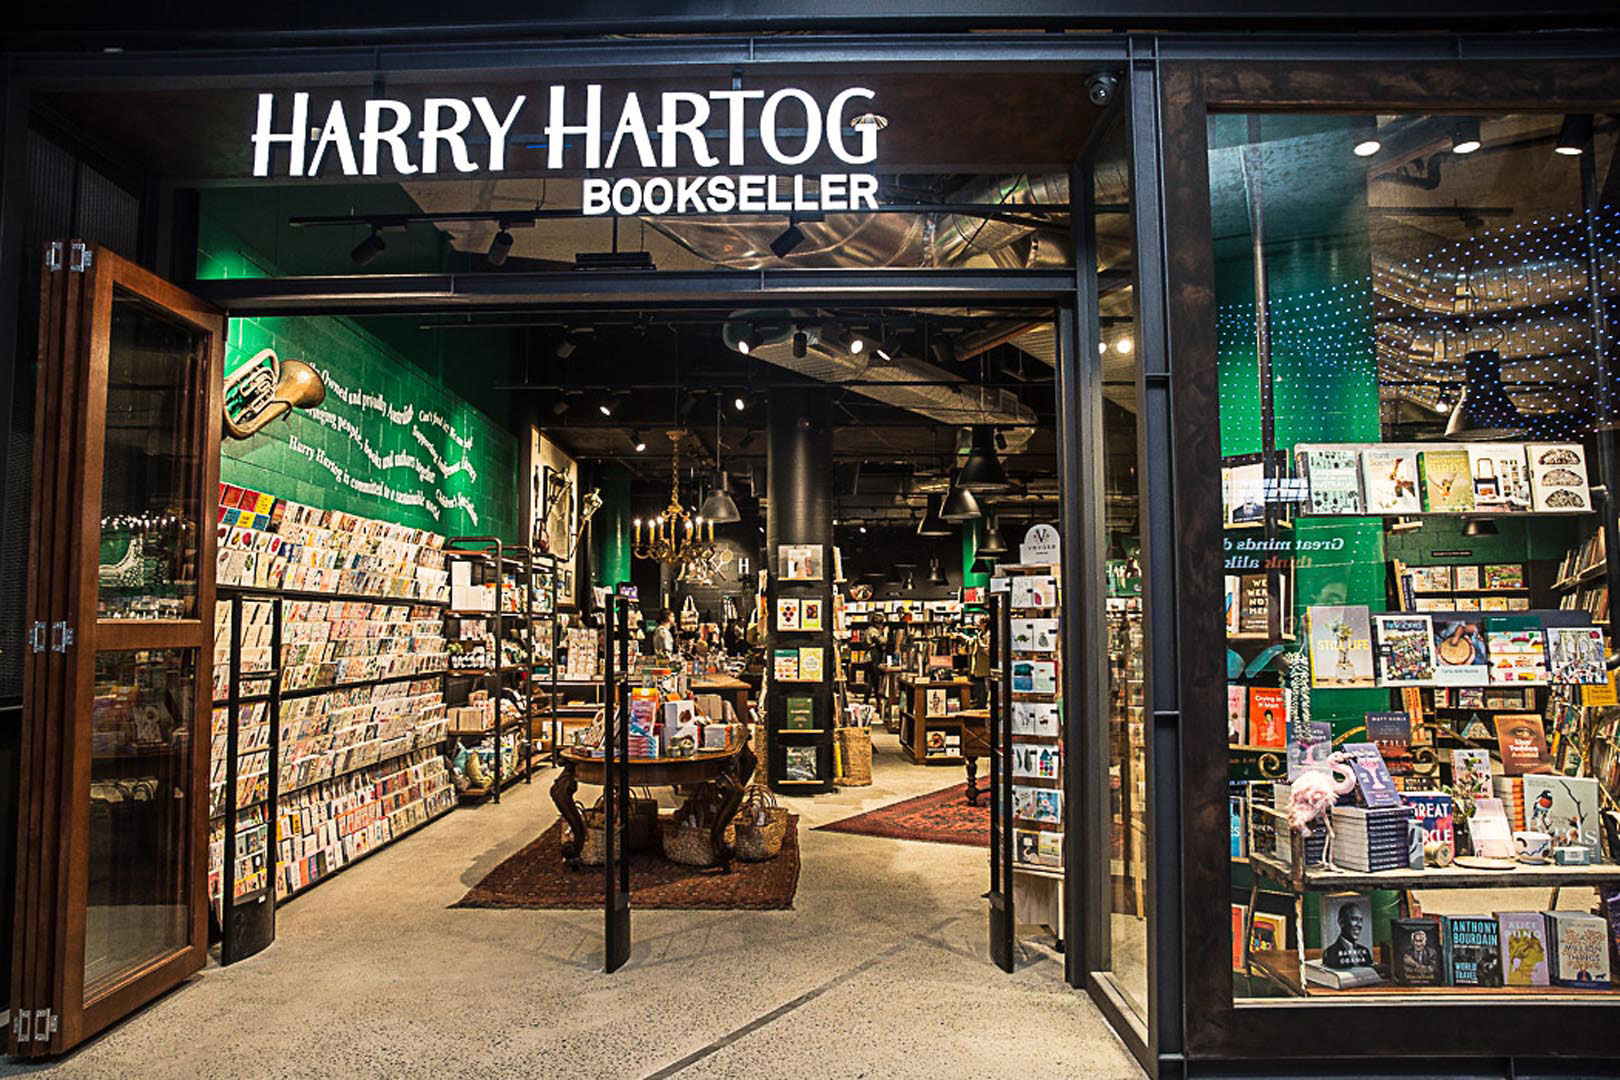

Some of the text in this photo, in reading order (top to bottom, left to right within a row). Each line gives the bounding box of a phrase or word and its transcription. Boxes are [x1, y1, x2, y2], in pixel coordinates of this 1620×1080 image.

[252, 84, 887, 177] HARRY HARTOG
[583, 174, 879, 215] BOOKSELLER
[321, 370, 348, 401] Owned
[348, 389, 361, 404] and
[305, 406, 336, 430] ringing
[289, 434, 314, 461] Harry
[315, 447, 343, 482] Hartog
[350, 478, 384, 496] committed
[1429, 463, 1467, 473] BIRDS
[1253, 578, 1267, 587] WE
[1246, 589, 1268, 597] WER
[1348, 639, 1369, 650] LIFE
[1255, 694, 1275, 704] Crying
[1452, 920, 1498, 935] ANTHONY
[1508, 921, 1537, 929] ALICE
[1452, 933, 1498, 946] BOURDAIN
[1564, 943, 1602, 953] MILLION
[1567, 954, 1601, 962] THINGS
